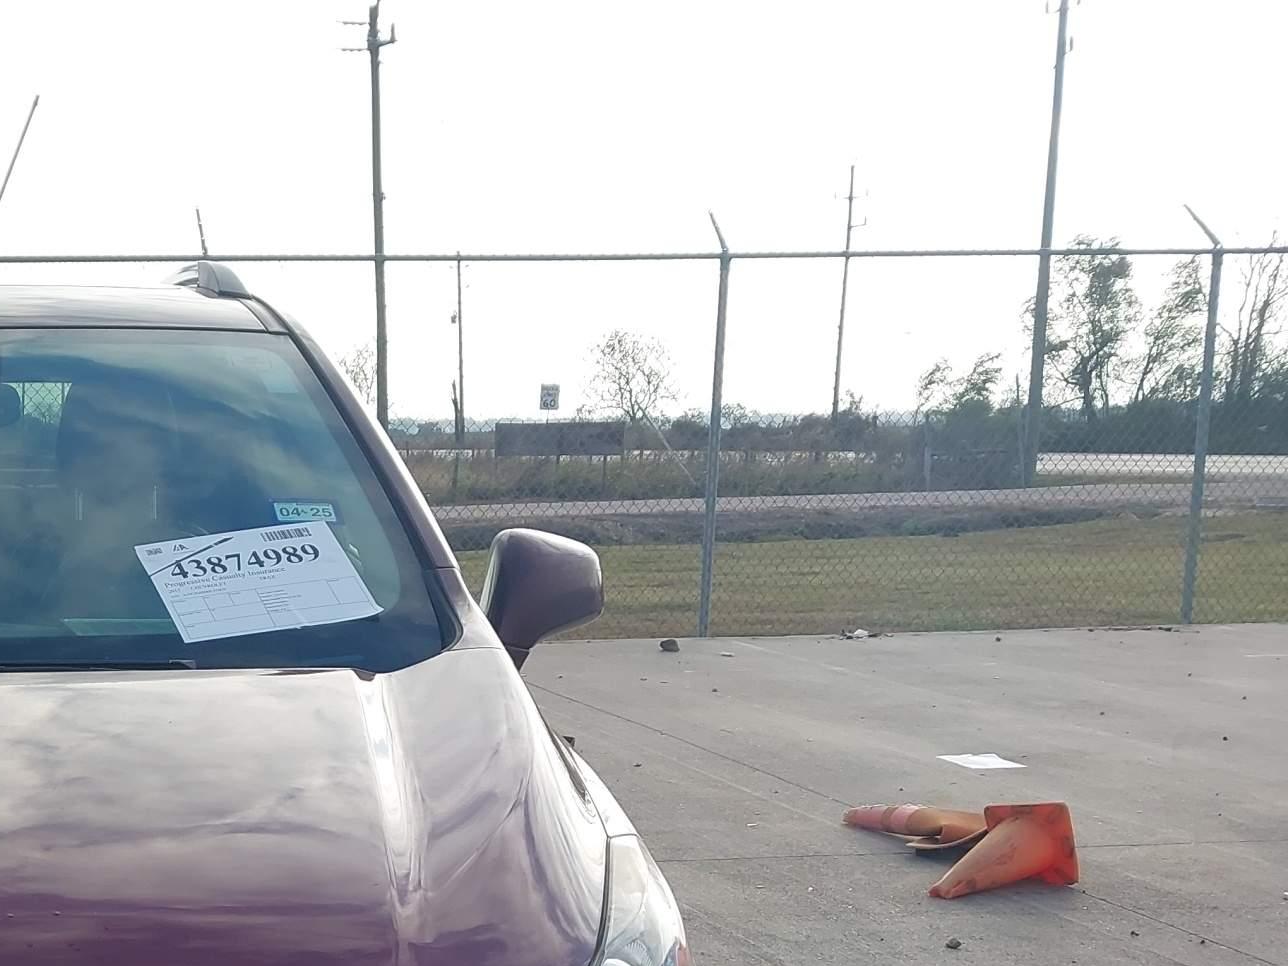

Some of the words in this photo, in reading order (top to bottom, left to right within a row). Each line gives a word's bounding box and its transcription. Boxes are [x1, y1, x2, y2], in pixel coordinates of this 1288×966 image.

[543, 399, 556, 408] 60
[170, 543, 320, 579] 43874989
[211, 570, 246, 583] Casualty
